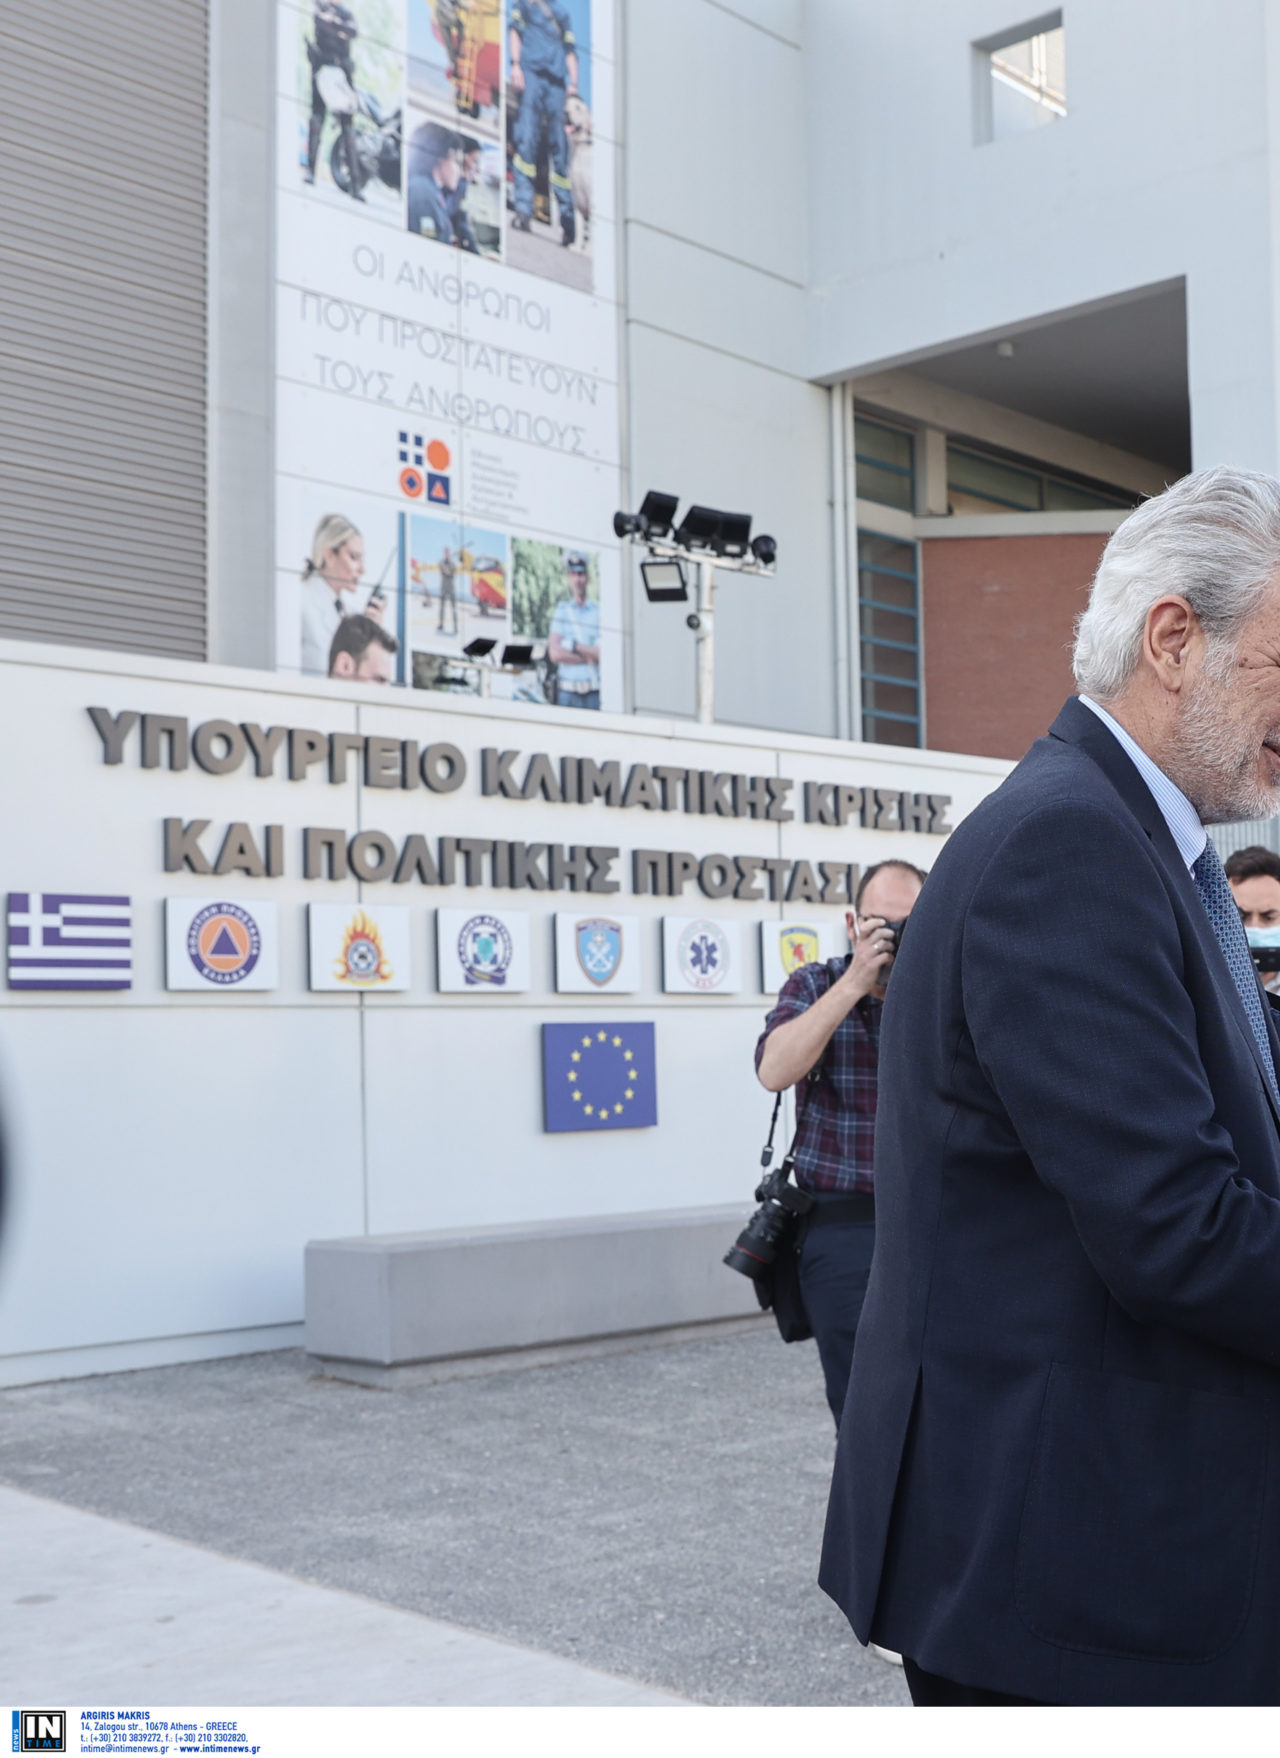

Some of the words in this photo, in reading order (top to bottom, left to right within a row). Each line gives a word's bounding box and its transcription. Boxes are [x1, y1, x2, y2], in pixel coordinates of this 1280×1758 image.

[352, 244, 385, 279] ΟΙ
[395, 260, 551, 333] ΑΝΘΡΩΠΟΙ
[300, 288, 369, 336] ΠΟΥ
[378, 314, 598, 406] ΠΡΟΣΤΑΤΕΥΟΥΝ
[313, 353, 395, 406] ΤΟΥΣ
[405, 381, 587, 457] ΑΝΘΡΩΠΟΥΣ
[86, 706, 468, 794] ΥΠΟΥΡΓΕΙΟ
[481, 747, 795, 822] ΚΛΙΜΑΤΙΚΗΣ
[803, 780, 953, 835] ΚΡΙΣΗΣ
[163, 817, 284, 877] ΚΑΙ
[303, 827, 620, 894] ΠΟΛΙΤΙΚΗΣ
[632, 848, 859, 905] ΠΡΟΣΤΑΣΙ
